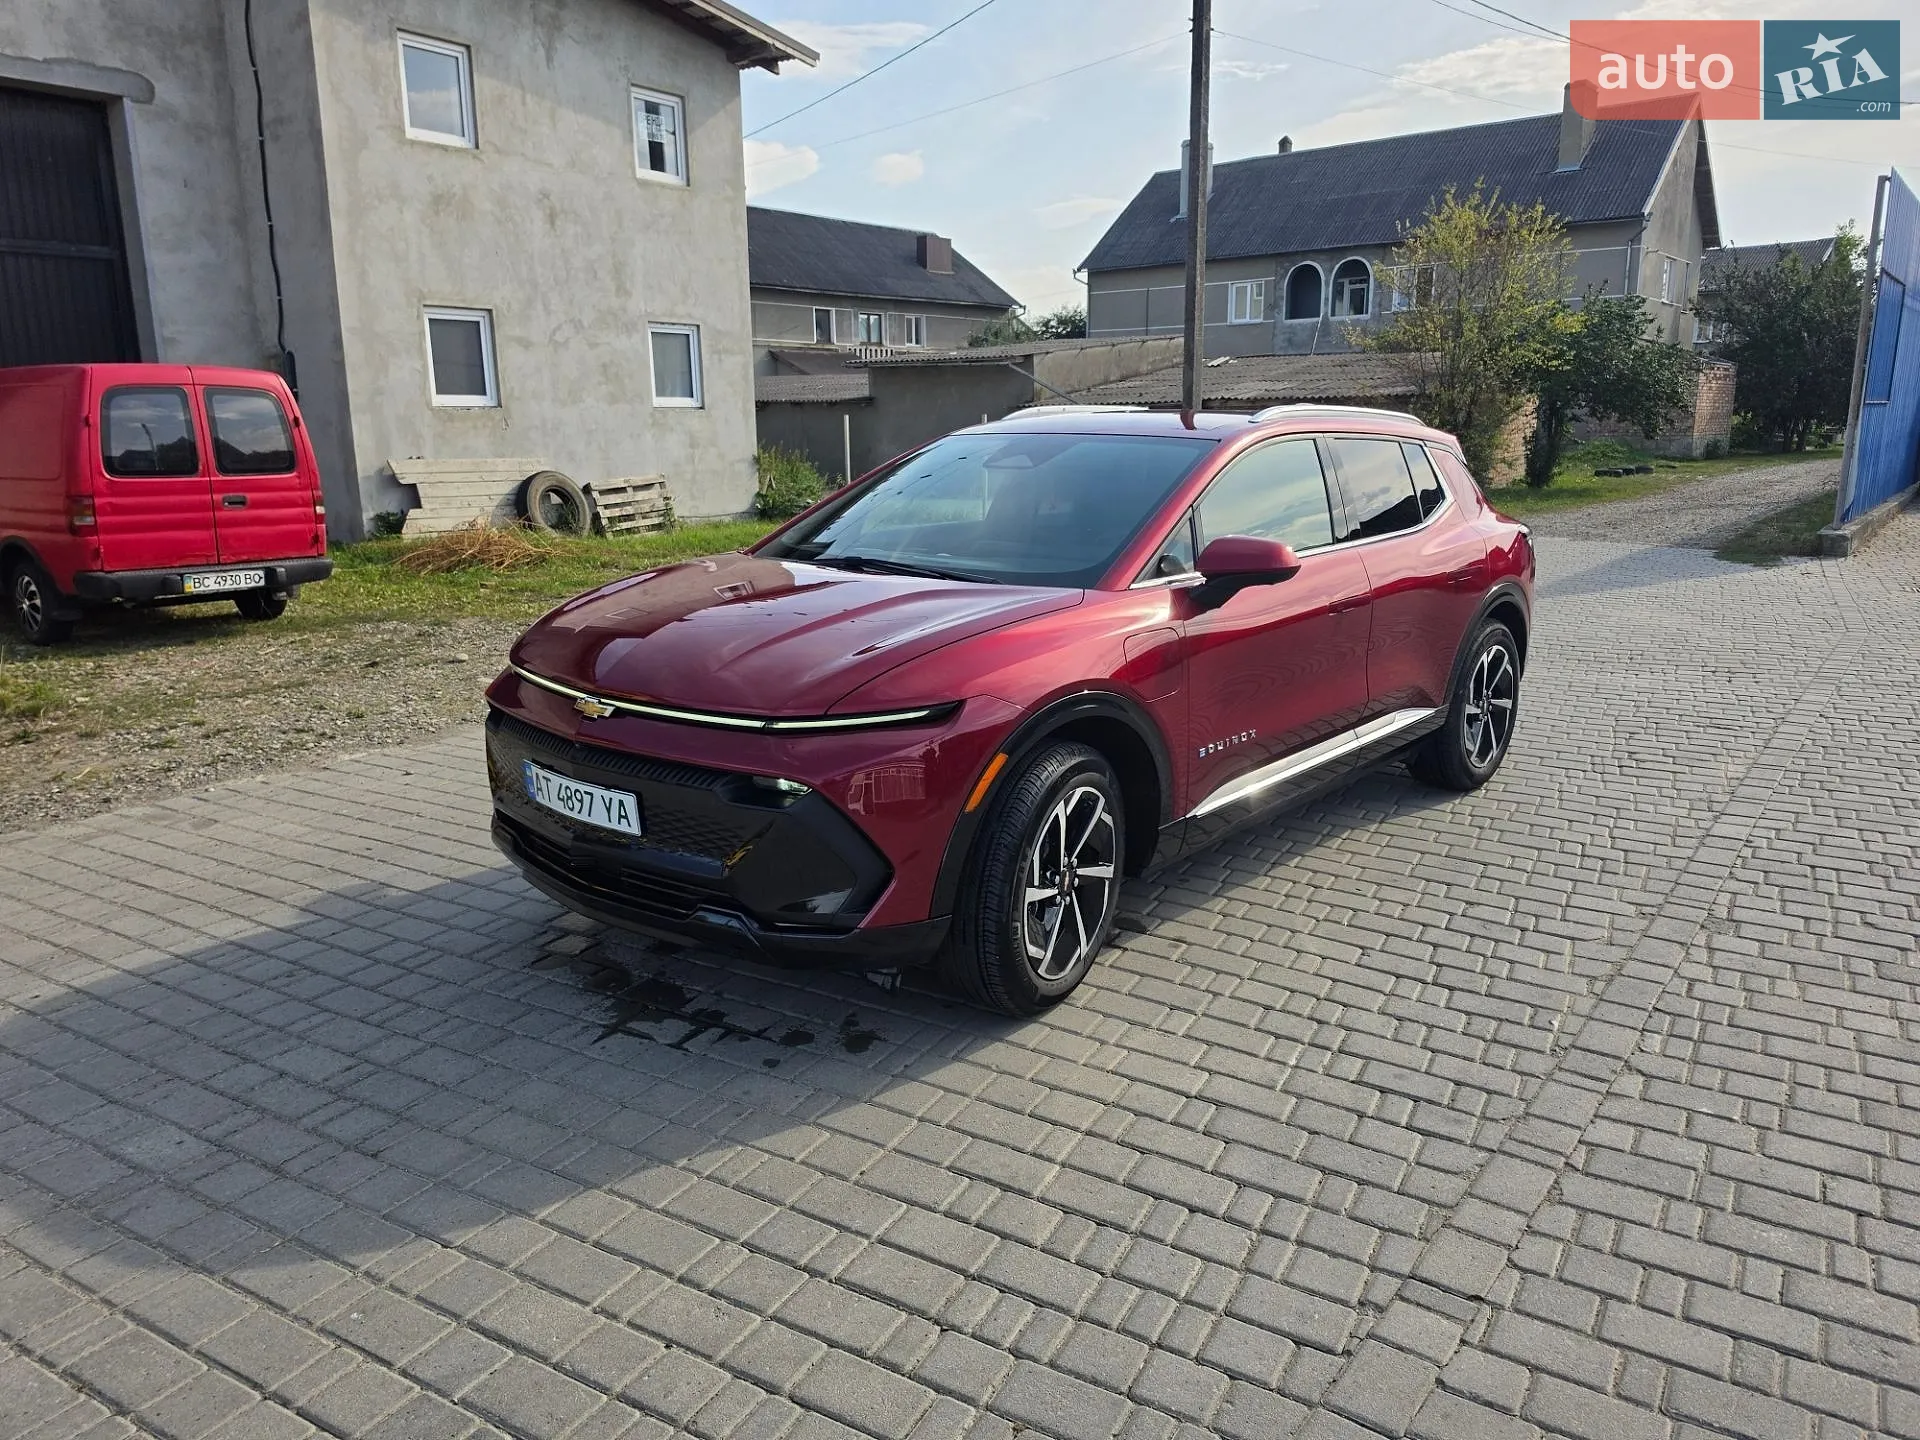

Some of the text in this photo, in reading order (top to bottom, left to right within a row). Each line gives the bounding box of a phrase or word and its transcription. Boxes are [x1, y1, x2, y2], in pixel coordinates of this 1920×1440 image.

[193, 573, 262, 588] BC 4930 BO
[1199, 729, 1256, 758] EQUINOX
[534, 772, 631, 828] AT 4897 YA
